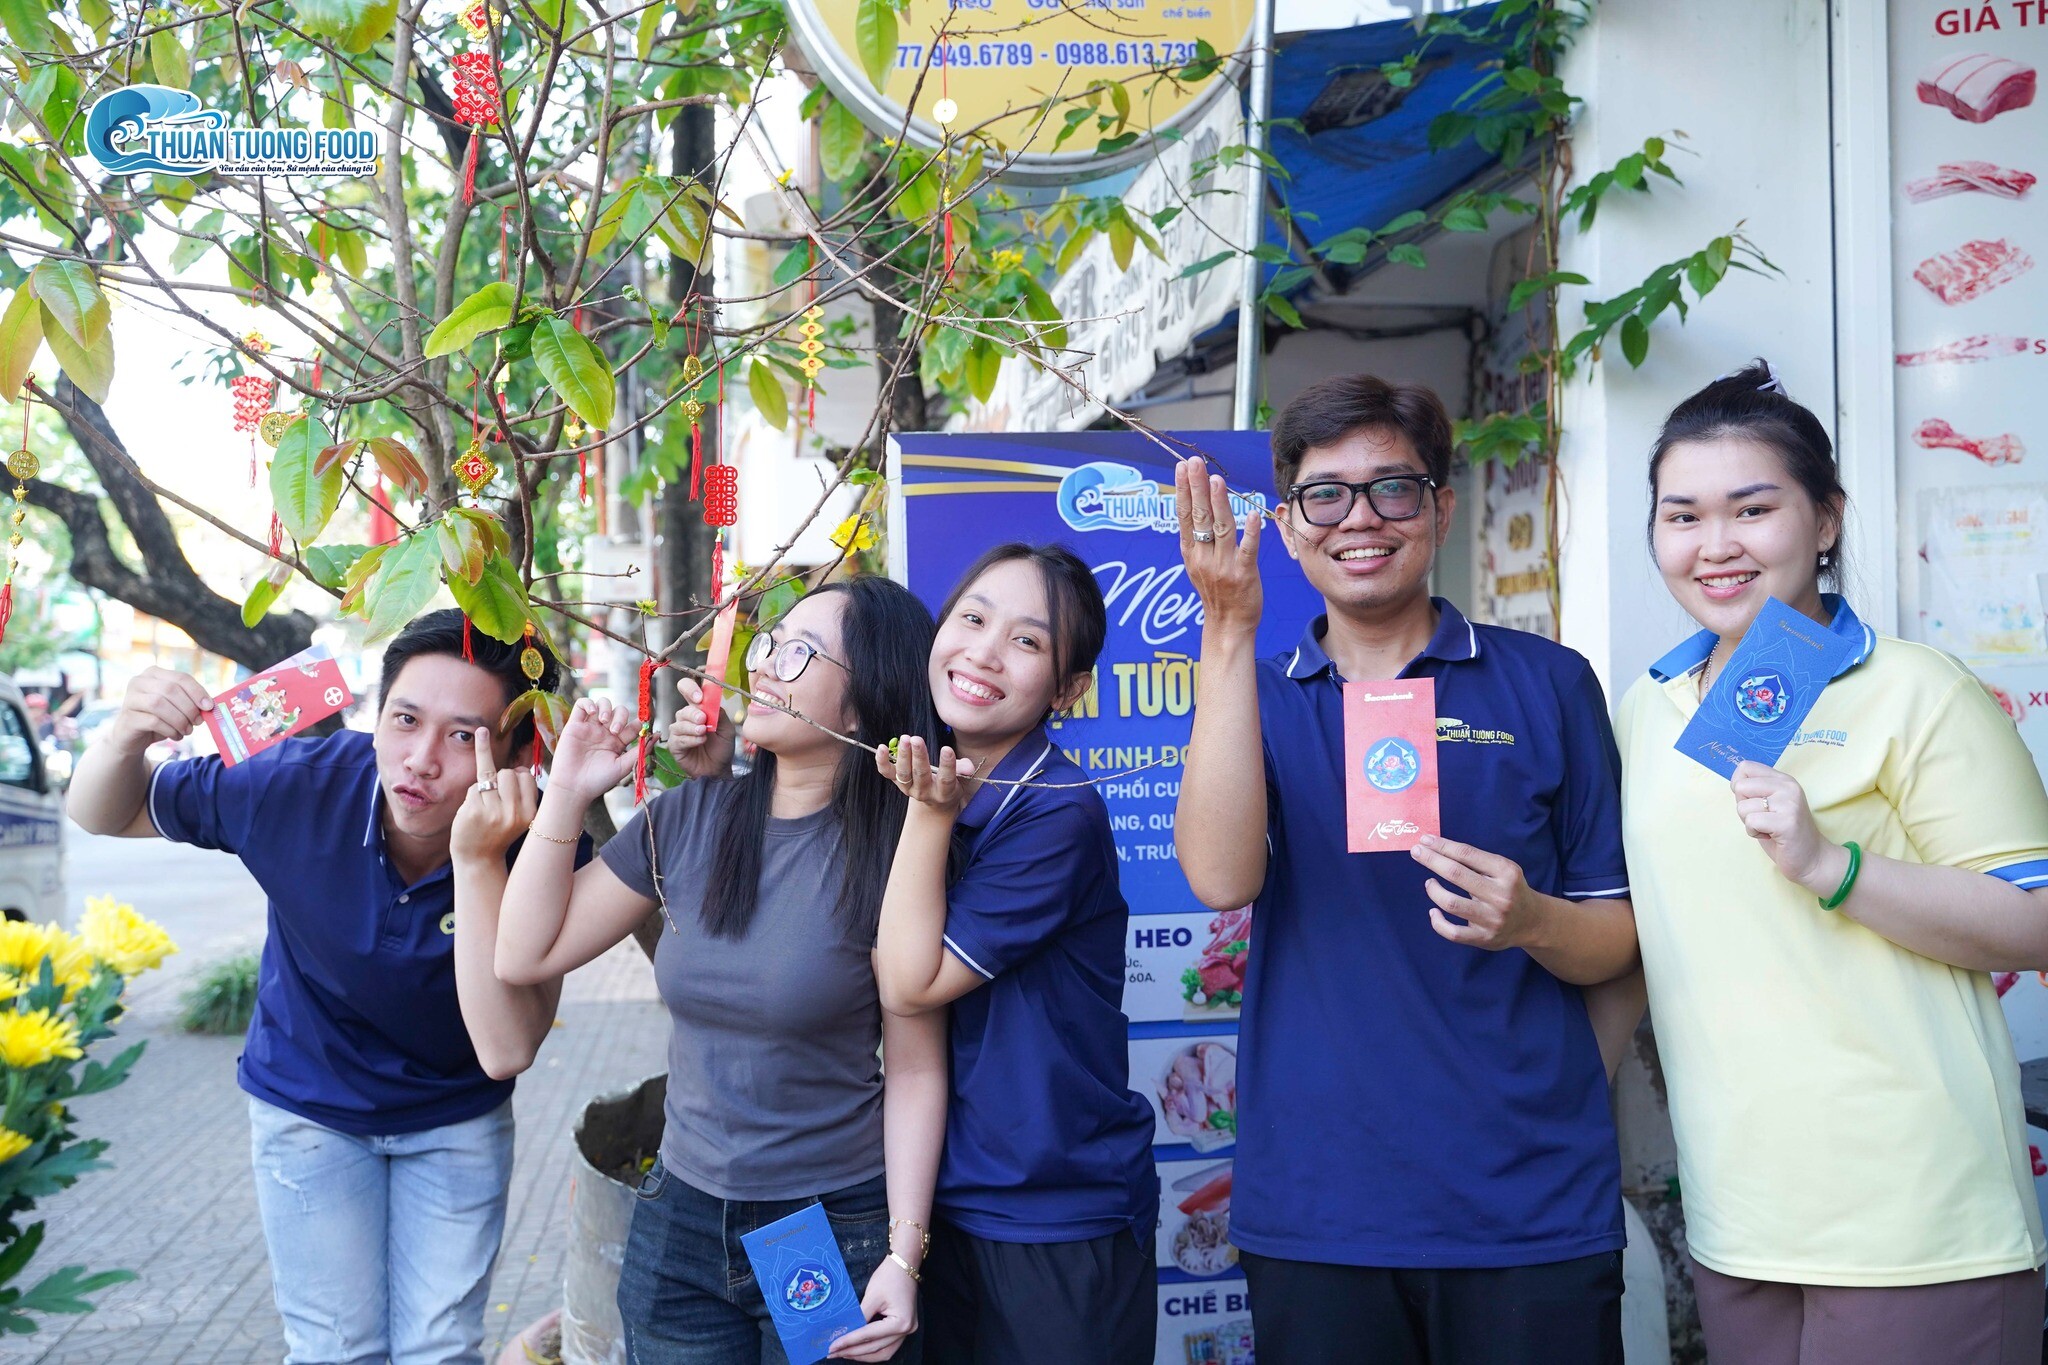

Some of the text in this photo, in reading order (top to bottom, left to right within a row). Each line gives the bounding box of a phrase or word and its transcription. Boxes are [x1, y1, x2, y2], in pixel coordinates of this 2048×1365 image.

[1090, 561, 1206, 645] Men
[1113, 651, 1201, 718] TƯỜ
[1089, 746, 1153, 770] KINH
[1106, 777, 1150, 799] PHỐI
[1135, 927, 1193, 948] HEO
[1164, 1288, 1217, 1316] CHẾ
